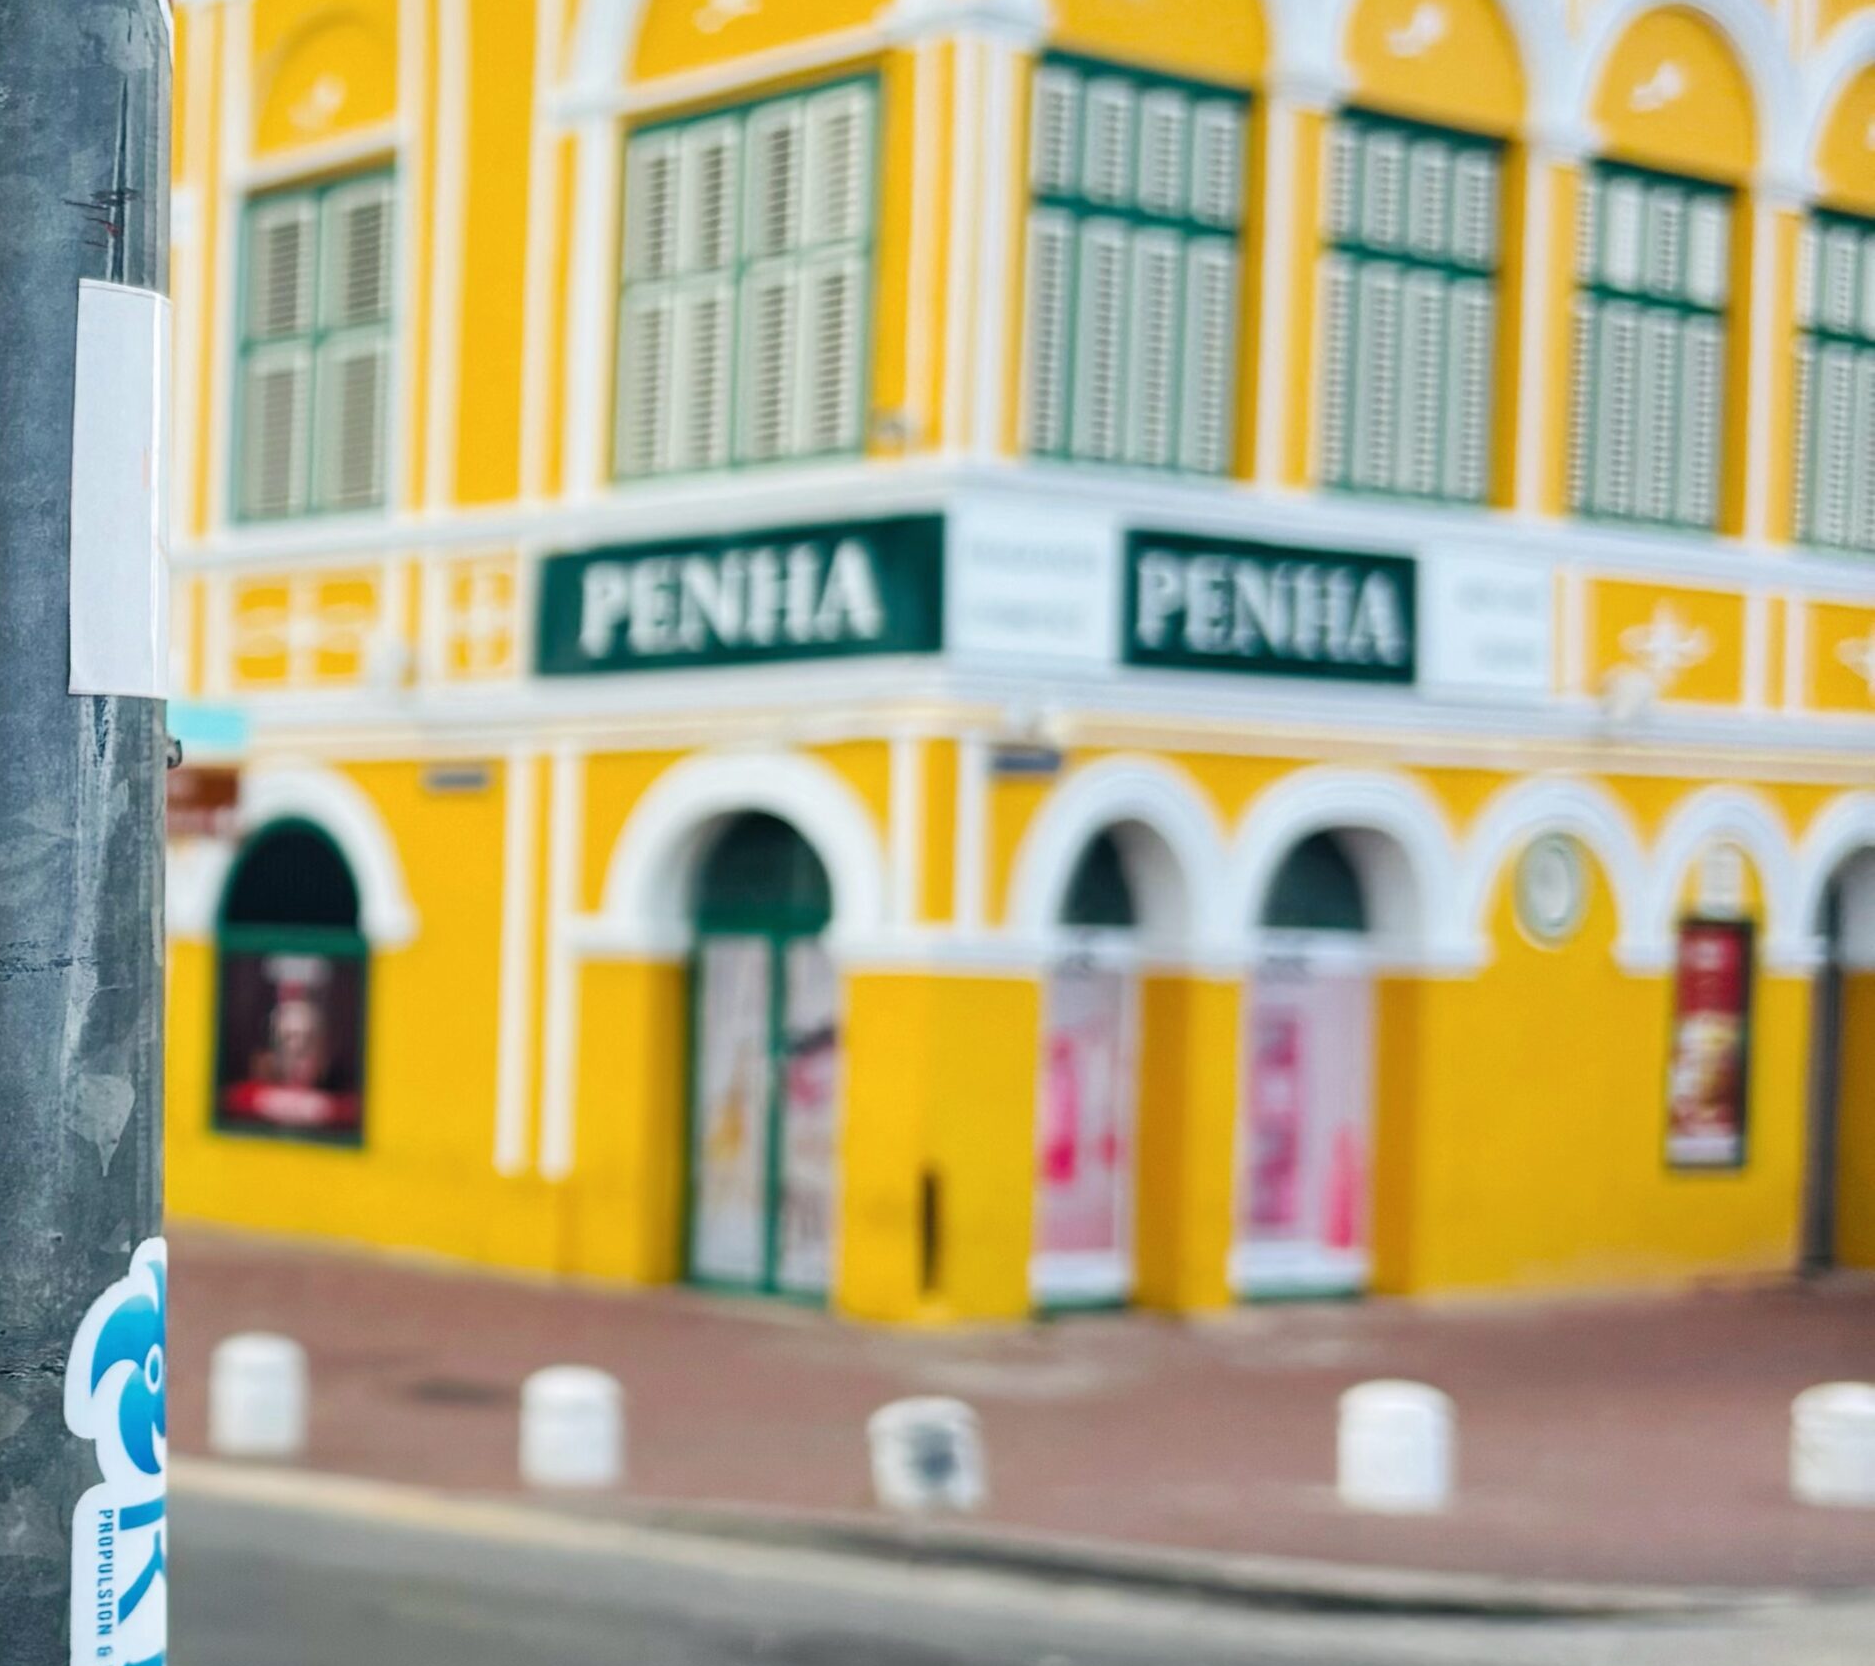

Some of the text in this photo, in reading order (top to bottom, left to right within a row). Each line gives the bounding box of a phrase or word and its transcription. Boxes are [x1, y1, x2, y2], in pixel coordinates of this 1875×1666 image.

[580, 536, 885, 659] PENHA
[1135, 550, 1410, 666] PENHA
[97, 1509, 114, 1636] PROPULSION
